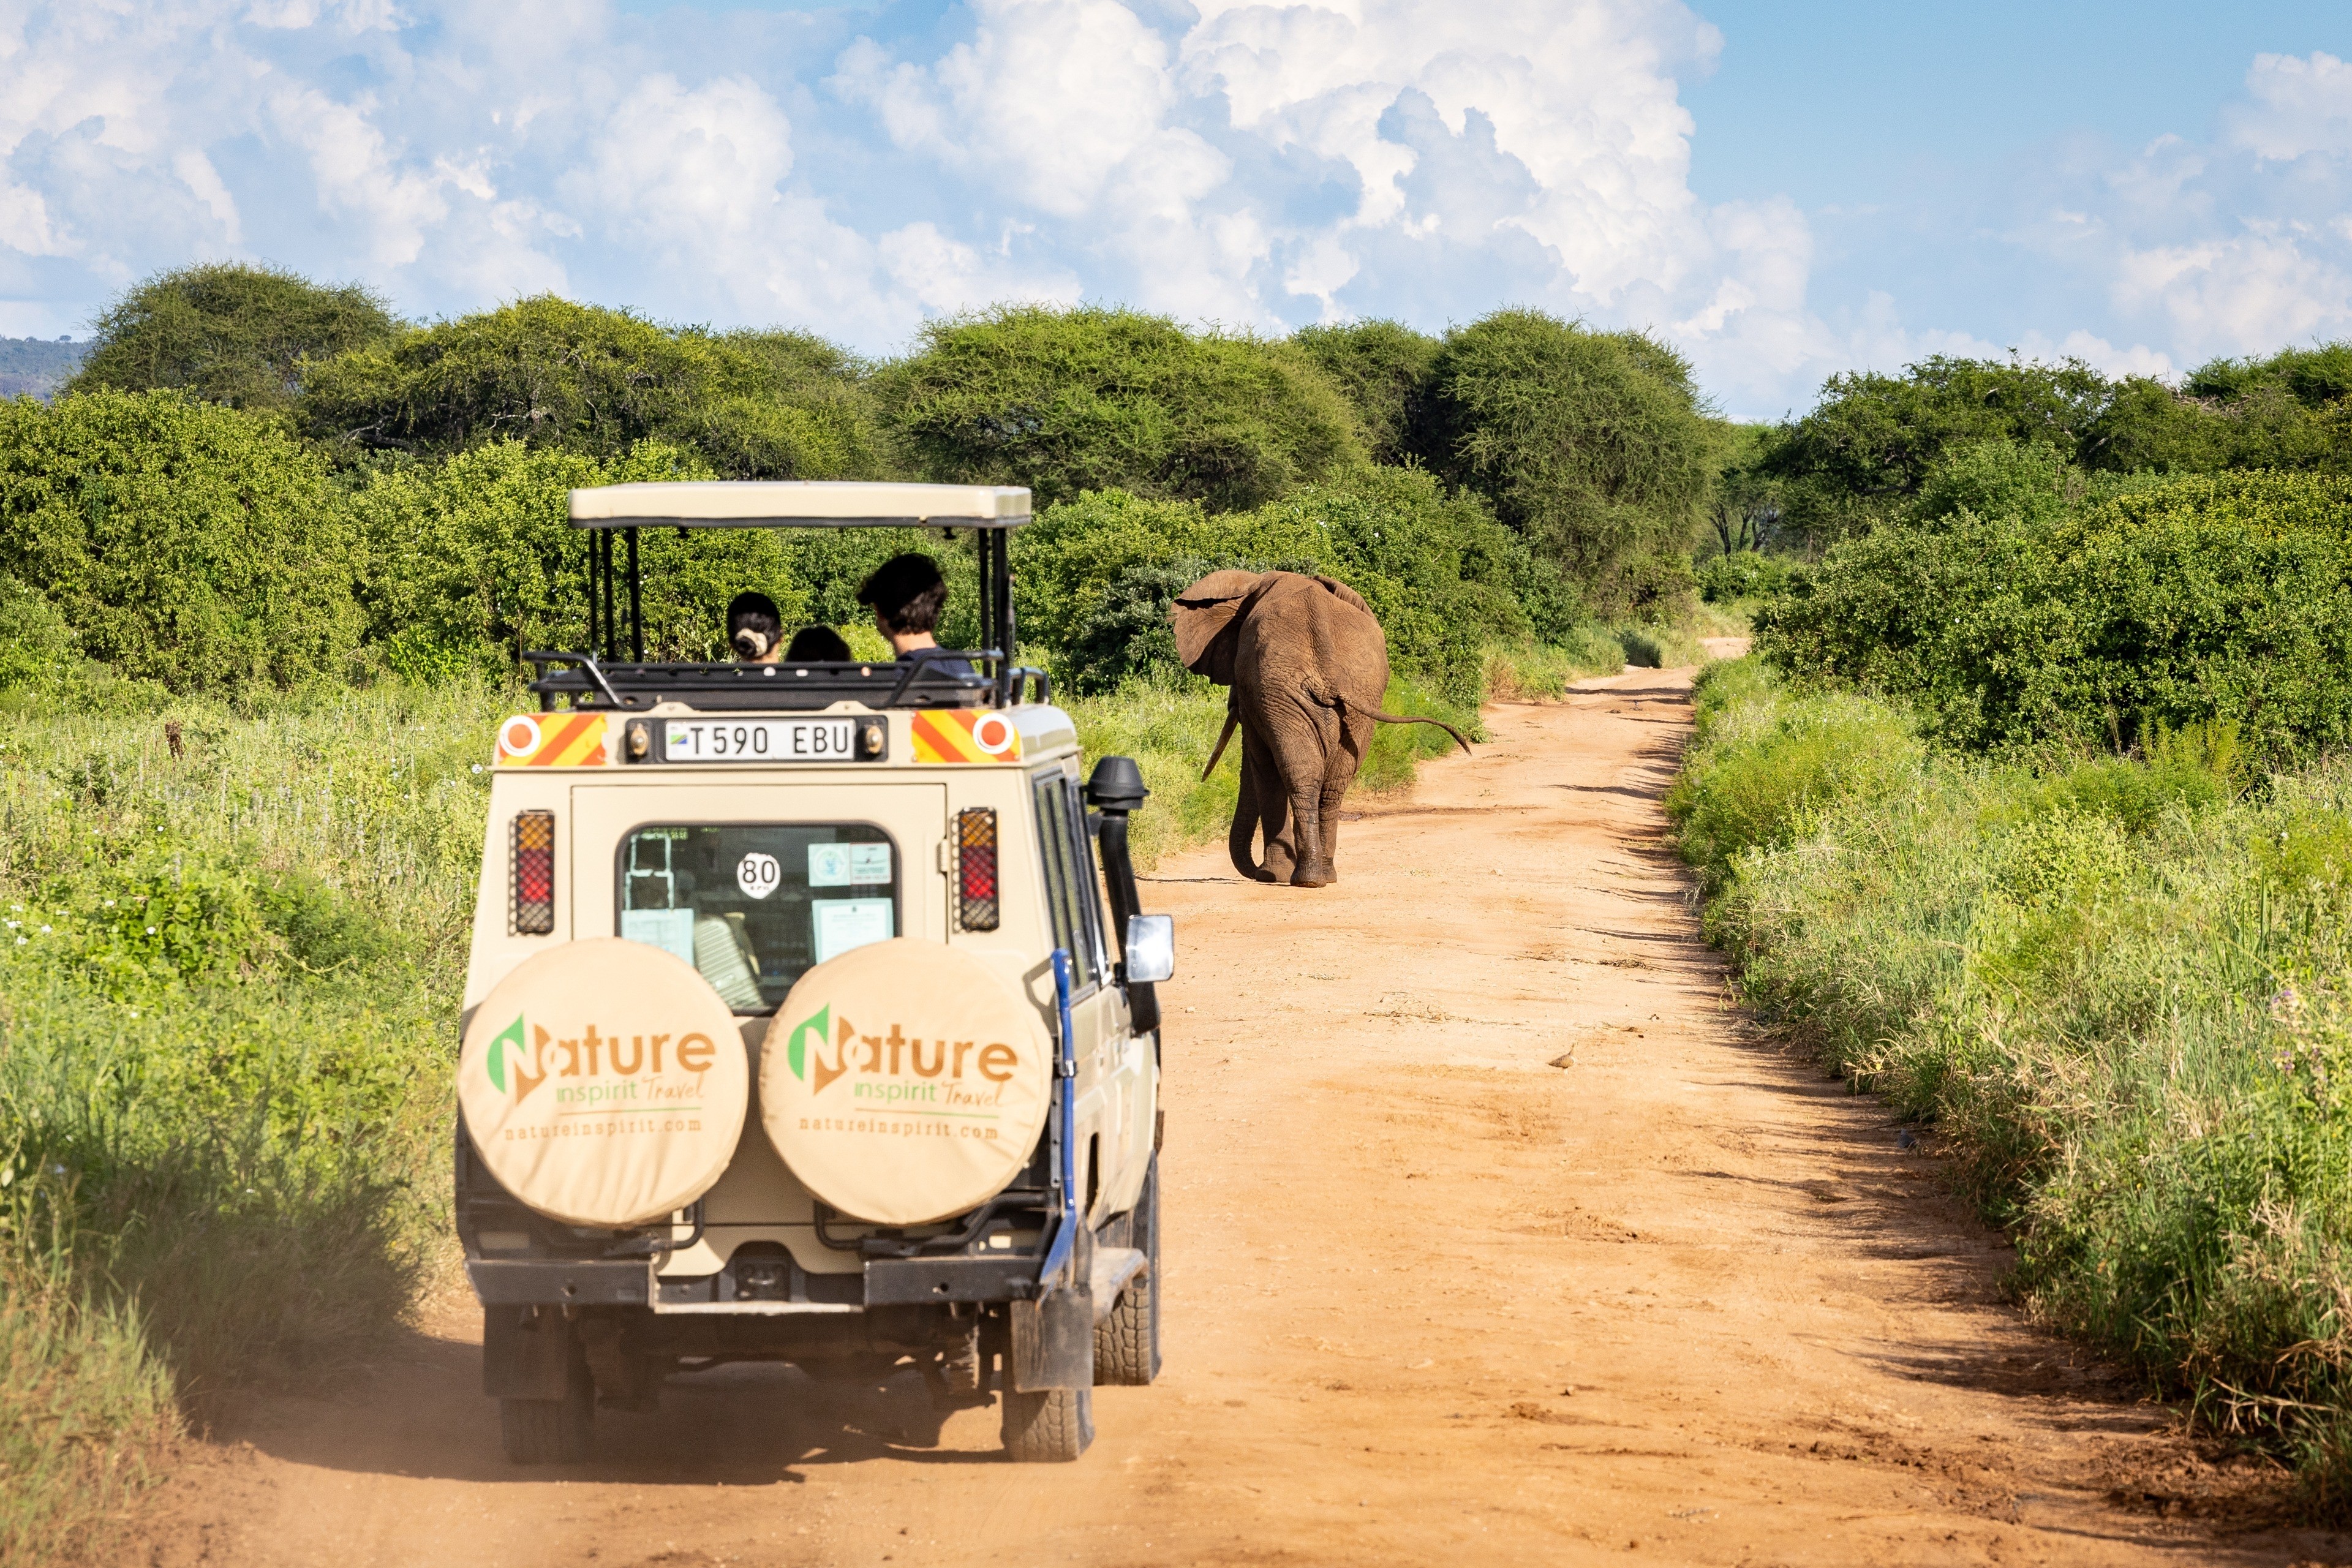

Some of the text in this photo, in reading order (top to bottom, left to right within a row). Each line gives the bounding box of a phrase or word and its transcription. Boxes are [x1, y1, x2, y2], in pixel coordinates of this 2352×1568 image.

[793, 726, 849, 754] EBU
[742, 860, 775, 883] 80
[487, 1012, 716, 1106] Nature
[788, 1002, 1018, 1096] Nature
[641, 1072, 705, 1101] Travel
[941, 1080, 1005, 1108] Travel
[505, 1118, 702, 1140] natureinspirit.com
[799, 1117, 999, 1140] natureinspirit.com
